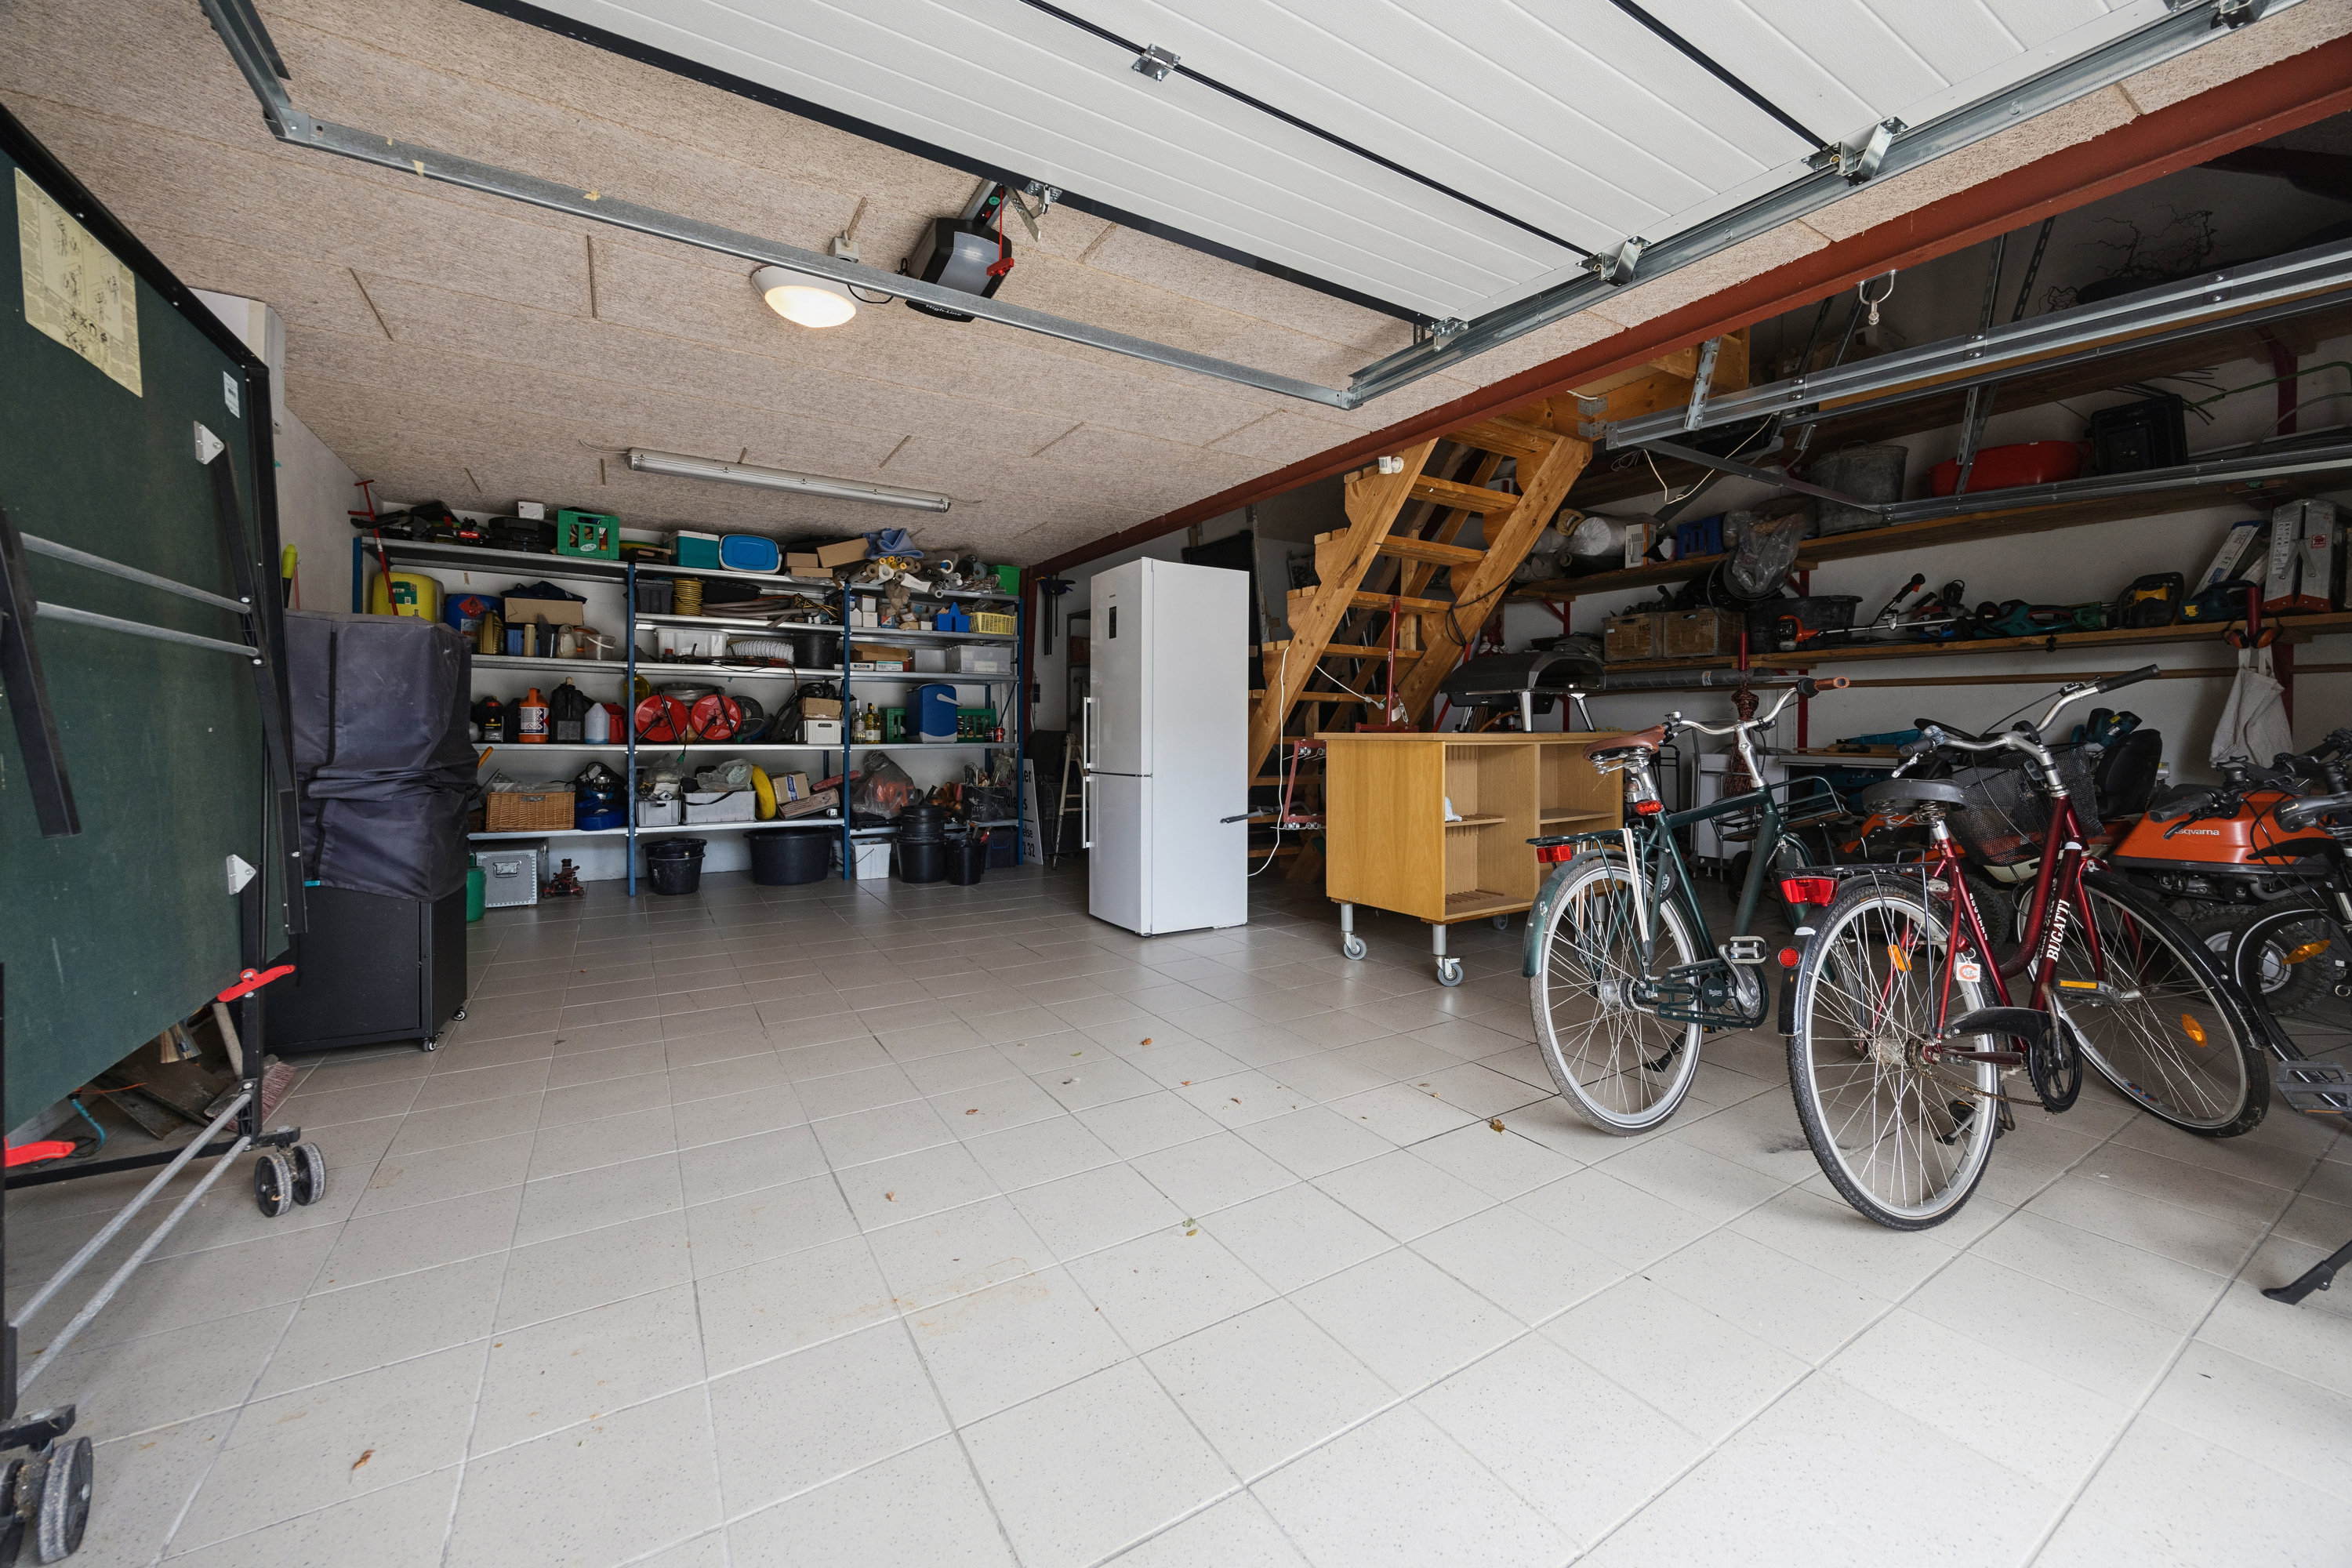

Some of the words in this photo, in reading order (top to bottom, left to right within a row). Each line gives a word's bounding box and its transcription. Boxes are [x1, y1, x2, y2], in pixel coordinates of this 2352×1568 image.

[925, 304, 962, 317] High-Line
[1969, 892, 1988, 941] BUGATTI
[2045, 898, 2071, 963] BUGATTI
